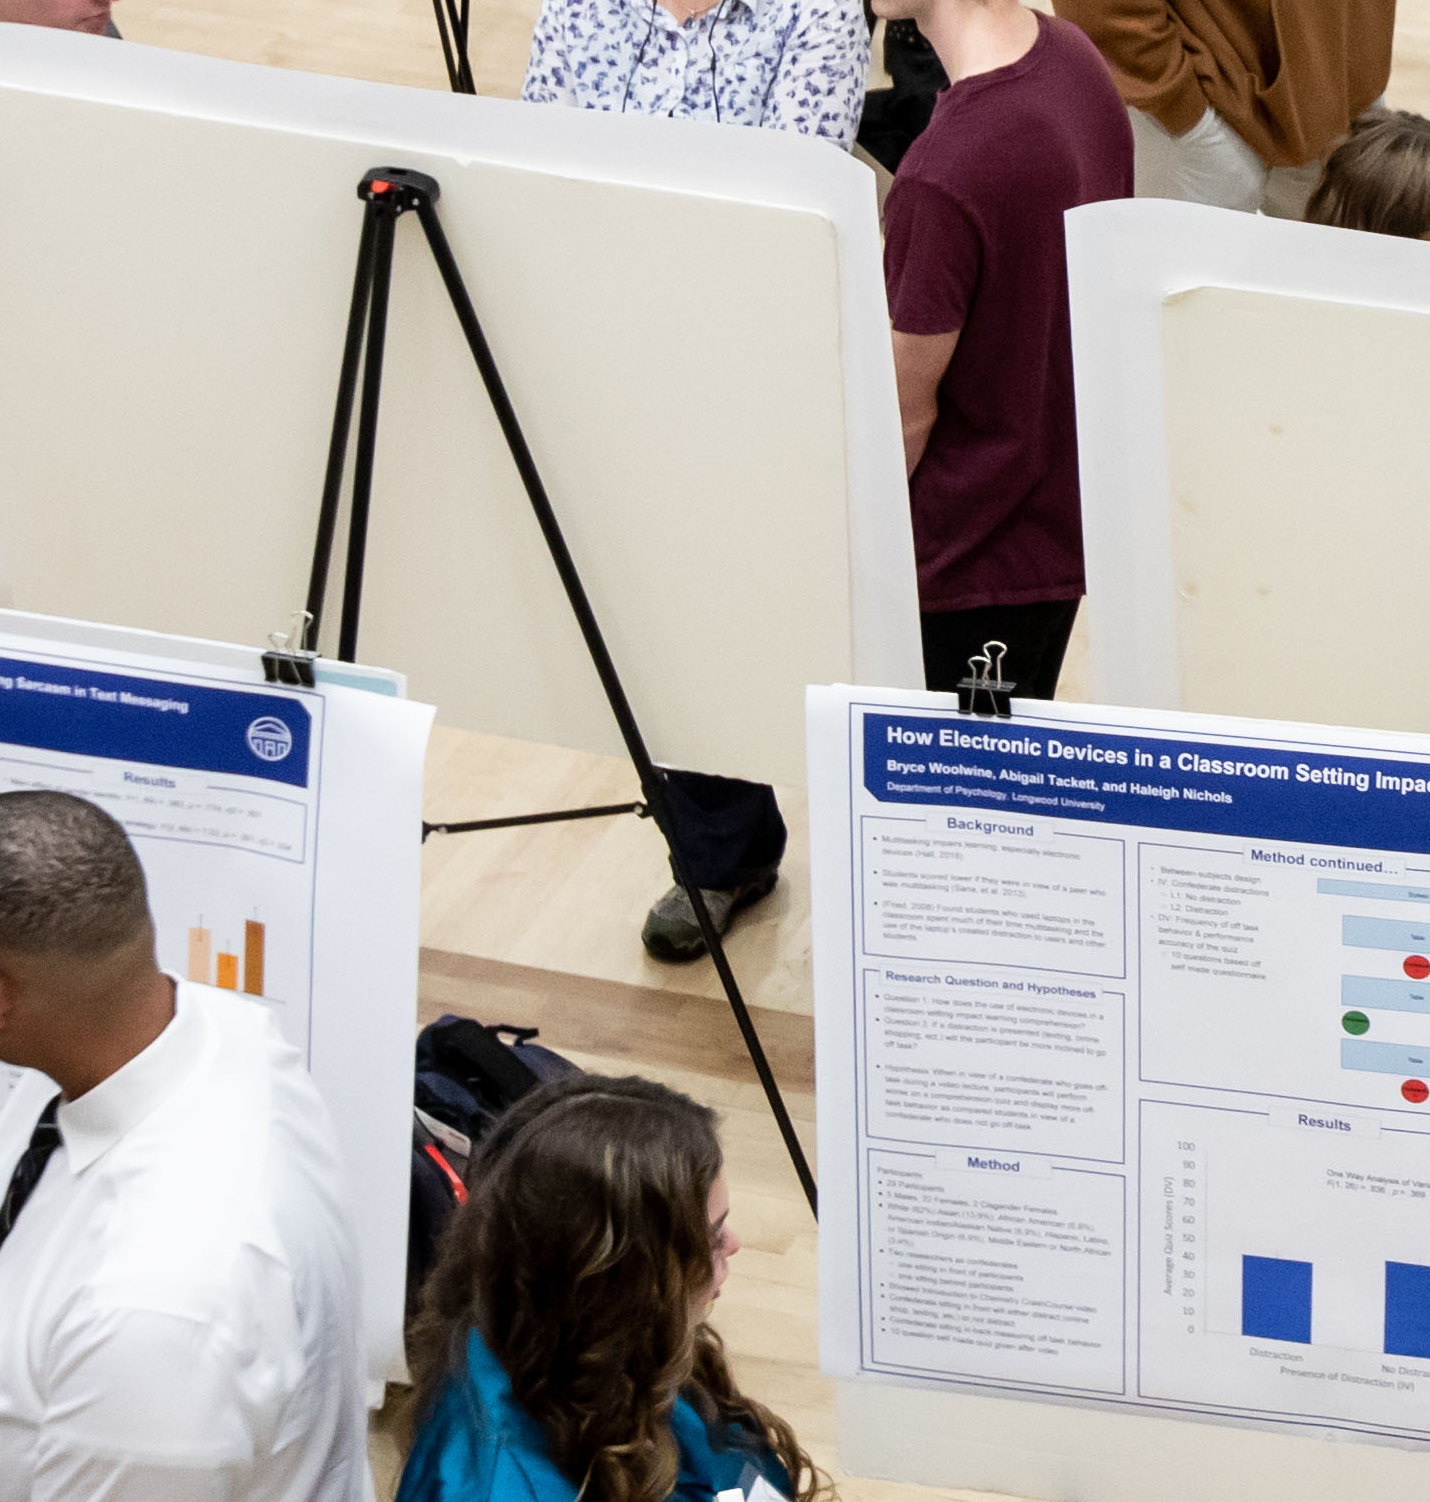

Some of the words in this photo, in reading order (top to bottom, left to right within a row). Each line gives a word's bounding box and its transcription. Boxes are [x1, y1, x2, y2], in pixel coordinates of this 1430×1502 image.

[886, 725, 933, 745] How
[939, 728, 1041, 756] Electronic
[1047, 739, 1128, 764] Devices
[1134, 748, 1153, 767] in
[1158, 754, 1171, 769] a
[1177, 752, 1288, 780] Classroom
[1295, 763, 1369, 791] Setting
[123, 771, 176, 788] Results
[886, 759, 925, 774] Bryce
[928, 761, 996, 779] Woolwine,
[998, 768, 1044, 785] Abigail
[1047, 773, 1098, 791] Tackett,
[1101, 781, 1126, 793] and
[1130, 782, 1179, 800] Haleigh
[1183, 787, 1232, 803] Nichols
[886, 780, 941, 793] Department
[1011, 792, 1058, 805] Longwood
[1060, 797, 1105, 812] University
[946, 816, 1033, 836] Background
[1250, 849, 1304, 865] Method
[885, 970, 941, 983] Research
[944, 975, 998, 987] Question
[1002, 981, 1023, 990] and
[1027, 982, 1096, 998] Hypotheses
[1298, 1113, 1351, 1131] Results
[967, 1156, 1019, 1172] Method
[1249, 1346, 1303, 1362] Distraction
[1380, 1364, 1396, 1374] No
